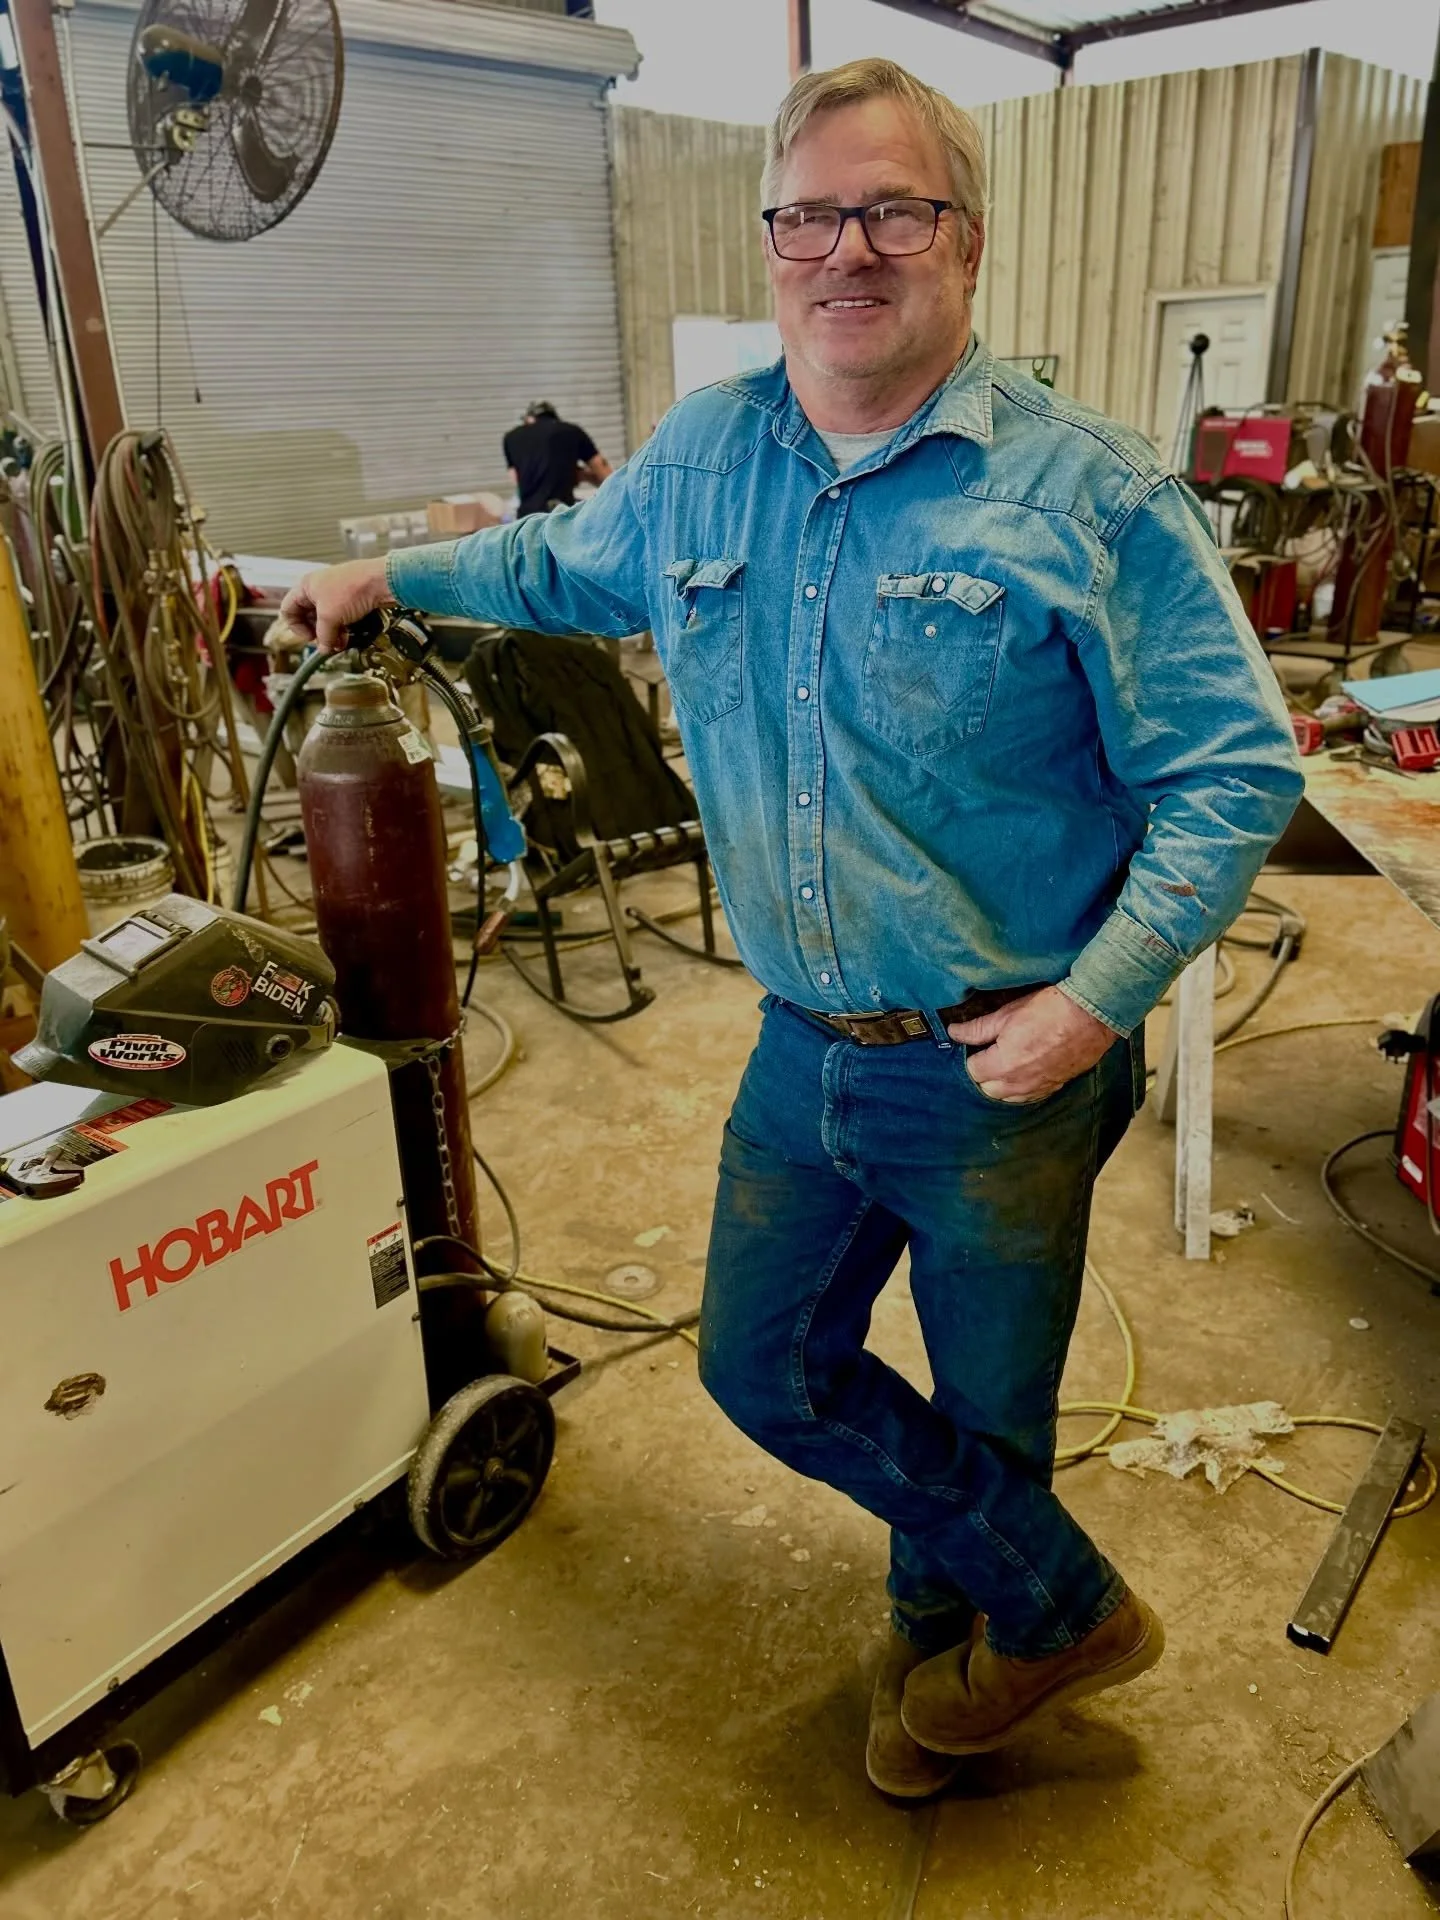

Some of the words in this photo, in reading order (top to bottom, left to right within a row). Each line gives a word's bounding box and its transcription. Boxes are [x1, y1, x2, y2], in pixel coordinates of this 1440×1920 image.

[252, 975, 307, 1014] BIDEN
[99, 1048, 177, 1062] Works
[108, 1040, 169, 1052] Pivot
[109, 1158, 319, 1312] HOBART
